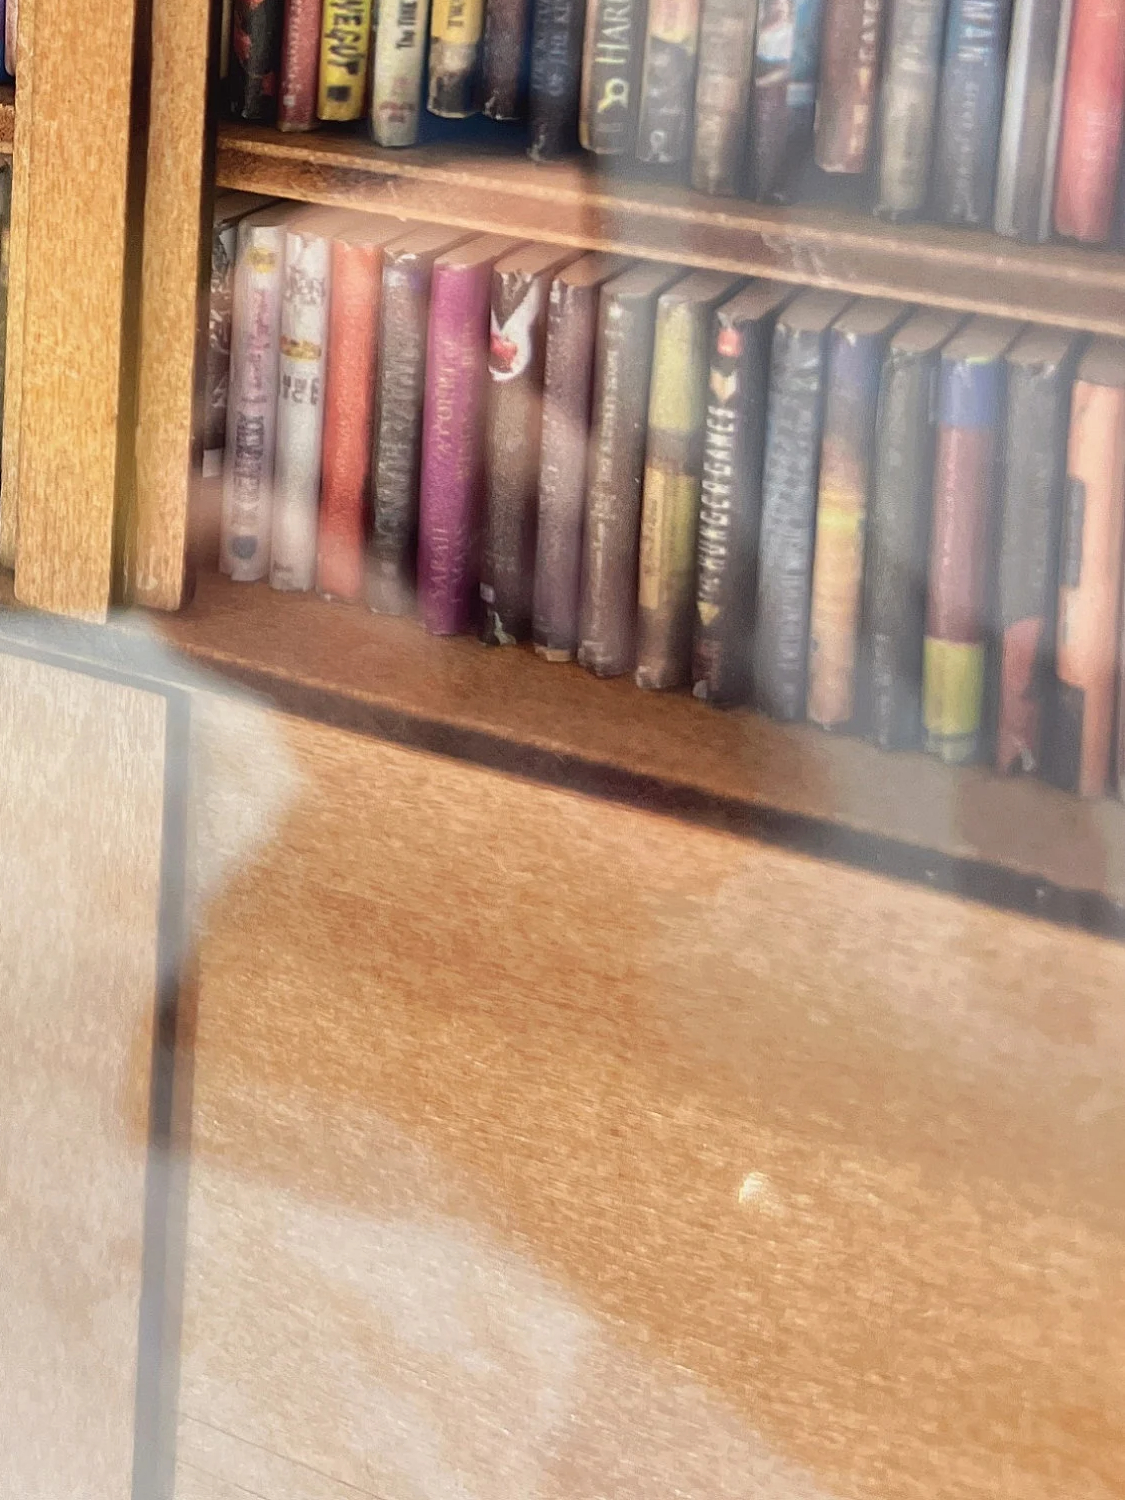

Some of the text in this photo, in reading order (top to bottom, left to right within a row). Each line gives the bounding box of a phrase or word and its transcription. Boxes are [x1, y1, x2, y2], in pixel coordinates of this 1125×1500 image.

[394, 30, 416, 50] The
[704, 404, 735, 475] GAMES
[699, 479, 730, 568] HUNGER
